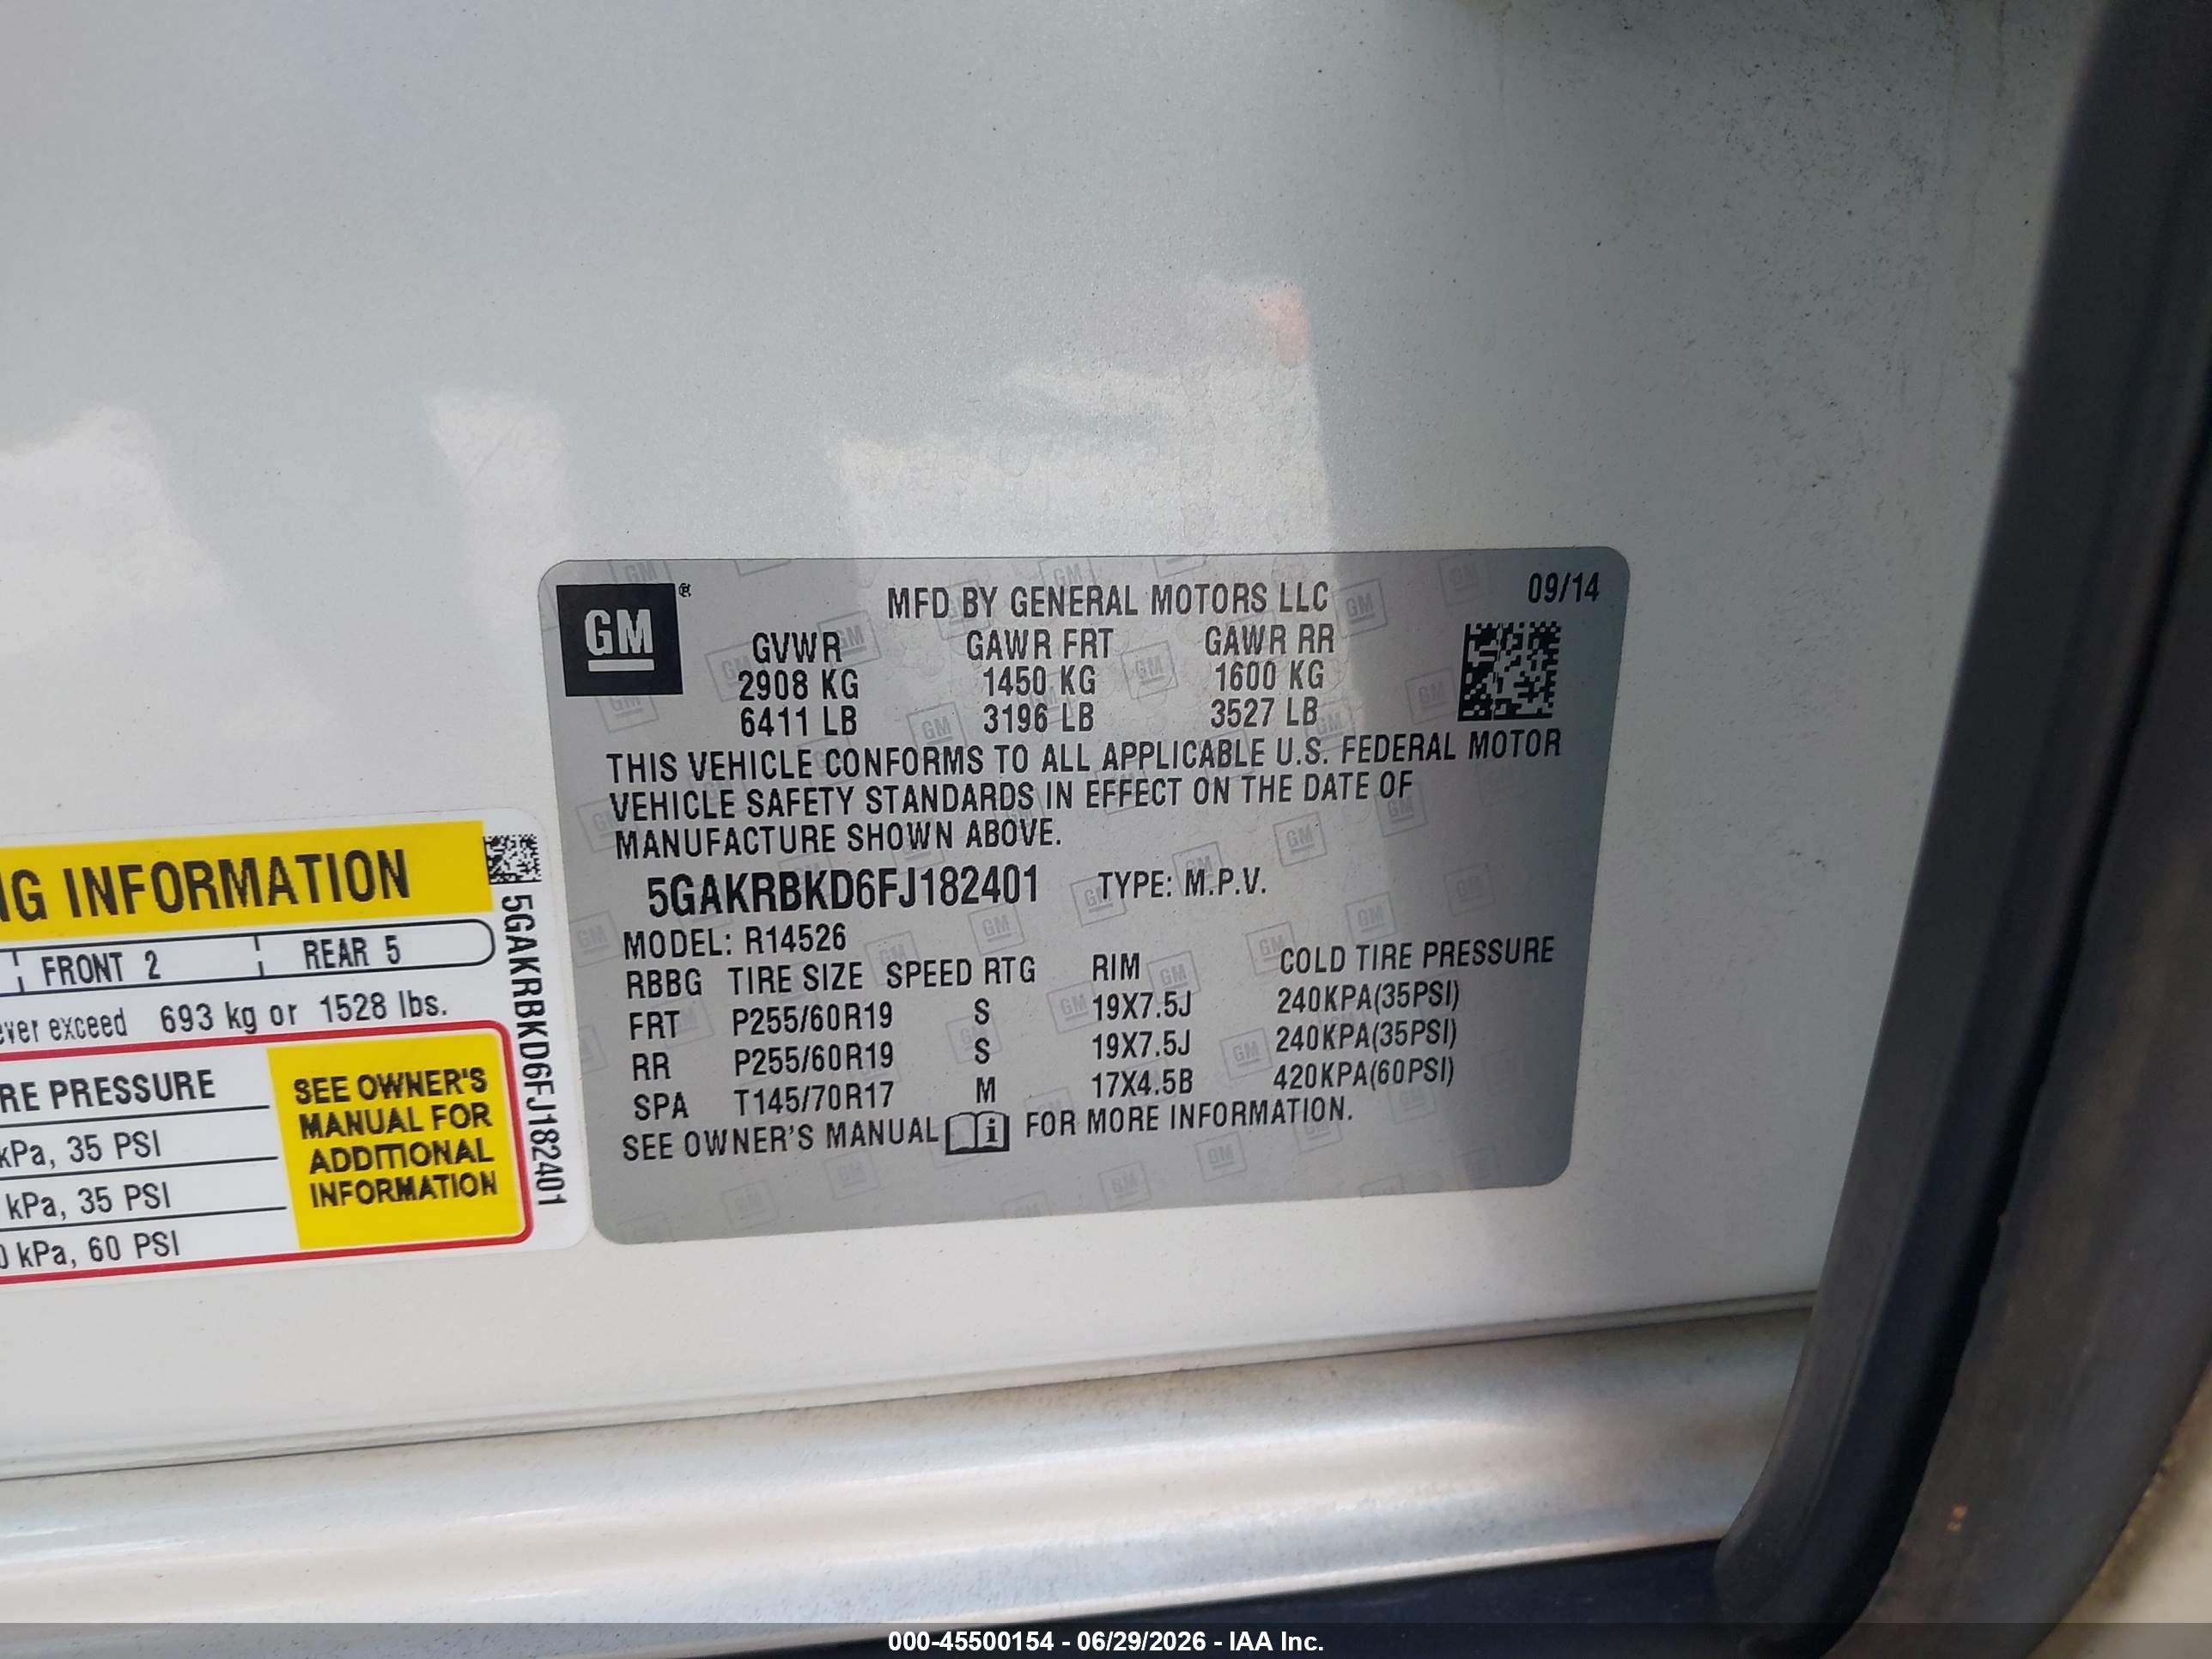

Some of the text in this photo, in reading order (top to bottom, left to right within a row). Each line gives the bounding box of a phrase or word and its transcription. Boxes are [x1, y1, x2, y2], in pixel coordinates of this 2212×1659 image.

[1053, 563, 1082, 587] GM
[1528, 572, 1599, 603] 09/14
[889, 587, 949, 618] MFD
[963, 586, 998, 618] BY
[1012, 585, 1138, 617] GENERAL
[1152, 583, 1267, 615] MOTORS
[1279, 581, 1328, 612] LLC
[1346, 592, 1374, 617] GM
[585, 609, 653, 655] GM
[753, 632, 842, 664] GVWR
[967, 629, 1114, 660] GAWR FRT
[1206, 623, 1334, 655] GAWR RR
[983, 665, 1095, 696] 1450 KG
[1134, 655, 1163, 678] GM
[1216, 659, 1323, 691] 1600 KG
[738, 669, 858, 701] 2908 KG
[741, 705, 856, 737] 6411 LB
[921, 716, 951, 739] GM
[984, 702, 1093, 733] 3196 LB
[1211, 696, 1317, 728] 3527 LB
[606, 728, 1560, 783] THIS VEHICLE CONFORMS TO ALL APPLICABLE U.S. FEDERAL MOTOR
[610, 789, 735, 822] VEHICLE
[747, 787, 854, 817] SAFETY
[866, 782, 1033, 814] STANDARDS
[1047, 781, 1072, 809] IN
[1087, 778, 1182, 808] EFFECT
[1194, 776, 1229, 805] ON
[1242, 775, 1291, 803] THE
[1304, 772, 1370, 801] DATE
[1380, 770, 1413, 798] OF
[1387, 796, 1413, 818] GM
[616, 817, 1060, 859] MANUFACTURE SHOWN ABOVE.
[1285, 823, 1315, 848] GM
[64, 849, 409, 917] INFORMATION
[647, 864, 1036, 917] 5GAKRBKD6FJ182401
[1098, 867, 1266, 899] TYPE: M.P.V.
[981, 915, 1011, 938] GM
[1357, 903, 1384, 928] GM
[303, 935, 400, 969] REAR 5
[624, 923, 846, 959] MODEL: R14526
[1259, 934, 1285, 957] GM
[41, 951, 161, 986] FRONT 2
[627, 936, 1554, 999] RBBG TIRE SIZE SPEED RTG RIM COLD TIRE PRESSURE
[1160, 963, 1188, 987] GM
[49, 1007, 127, 1041] exceed
[161, 1003, 213, 1033] 693
[225, 1001, 257, 1034] kg
[270, 1005, 296, 1026] or
[320, 992, 386, 1022] 1528
[399, 990, 447, 1018] lbs.
[629, 980, 1459, 1040] FRT P255/60R19 S 19X7.5J 240KPA(35PSI)
[1060, 994, 1088, 1016] GM
[501, 894, 568, 1206] 5GAKRBKD6FJ182401
[633, 1018, 1456, 1081] RR P255/60R19 S 19X7.5J 240KPA(35PSI)
[1233, 1041, 1261, 1064] GM
[49, 1070, 215, 1109] PRESSURE
[294, 1067, 487, 1104] SEE OWNER'S
[635, 1056, 1454, 1121] SPA T145/70R17 M 17X4.5B 420KPA(60PSI)
[299, 1103, 492, 1139] MANUAL FOR
[623, 1133, 672, 1161] SEE
[684, 1124, 813, 1158] OWNER'S
[827, 1117, 939, 1148] MANUAL
[1027, 1110, 1075, 1137] FOR
[1088, 1105, 1158, 1133] MORE
[1171, 1096, 1352, 1129] INFORMATION.
[67, 1134, 102, 1163] 35
[114, 1130, 161, 1159] PSI
[310, 1138, 494, 1174] ADDITIONAL
[1208, 1141, 1235, 1165] GM
[6, 1182, 170, 1220] kPa, 35 PSI
[311, 1171, 496, 1207] INFORMATION
[17, 1241, 76, 1268] kPa,
[88, 1236, 120, 1261] 60
[134, 1231, 179, 1259] PSI
